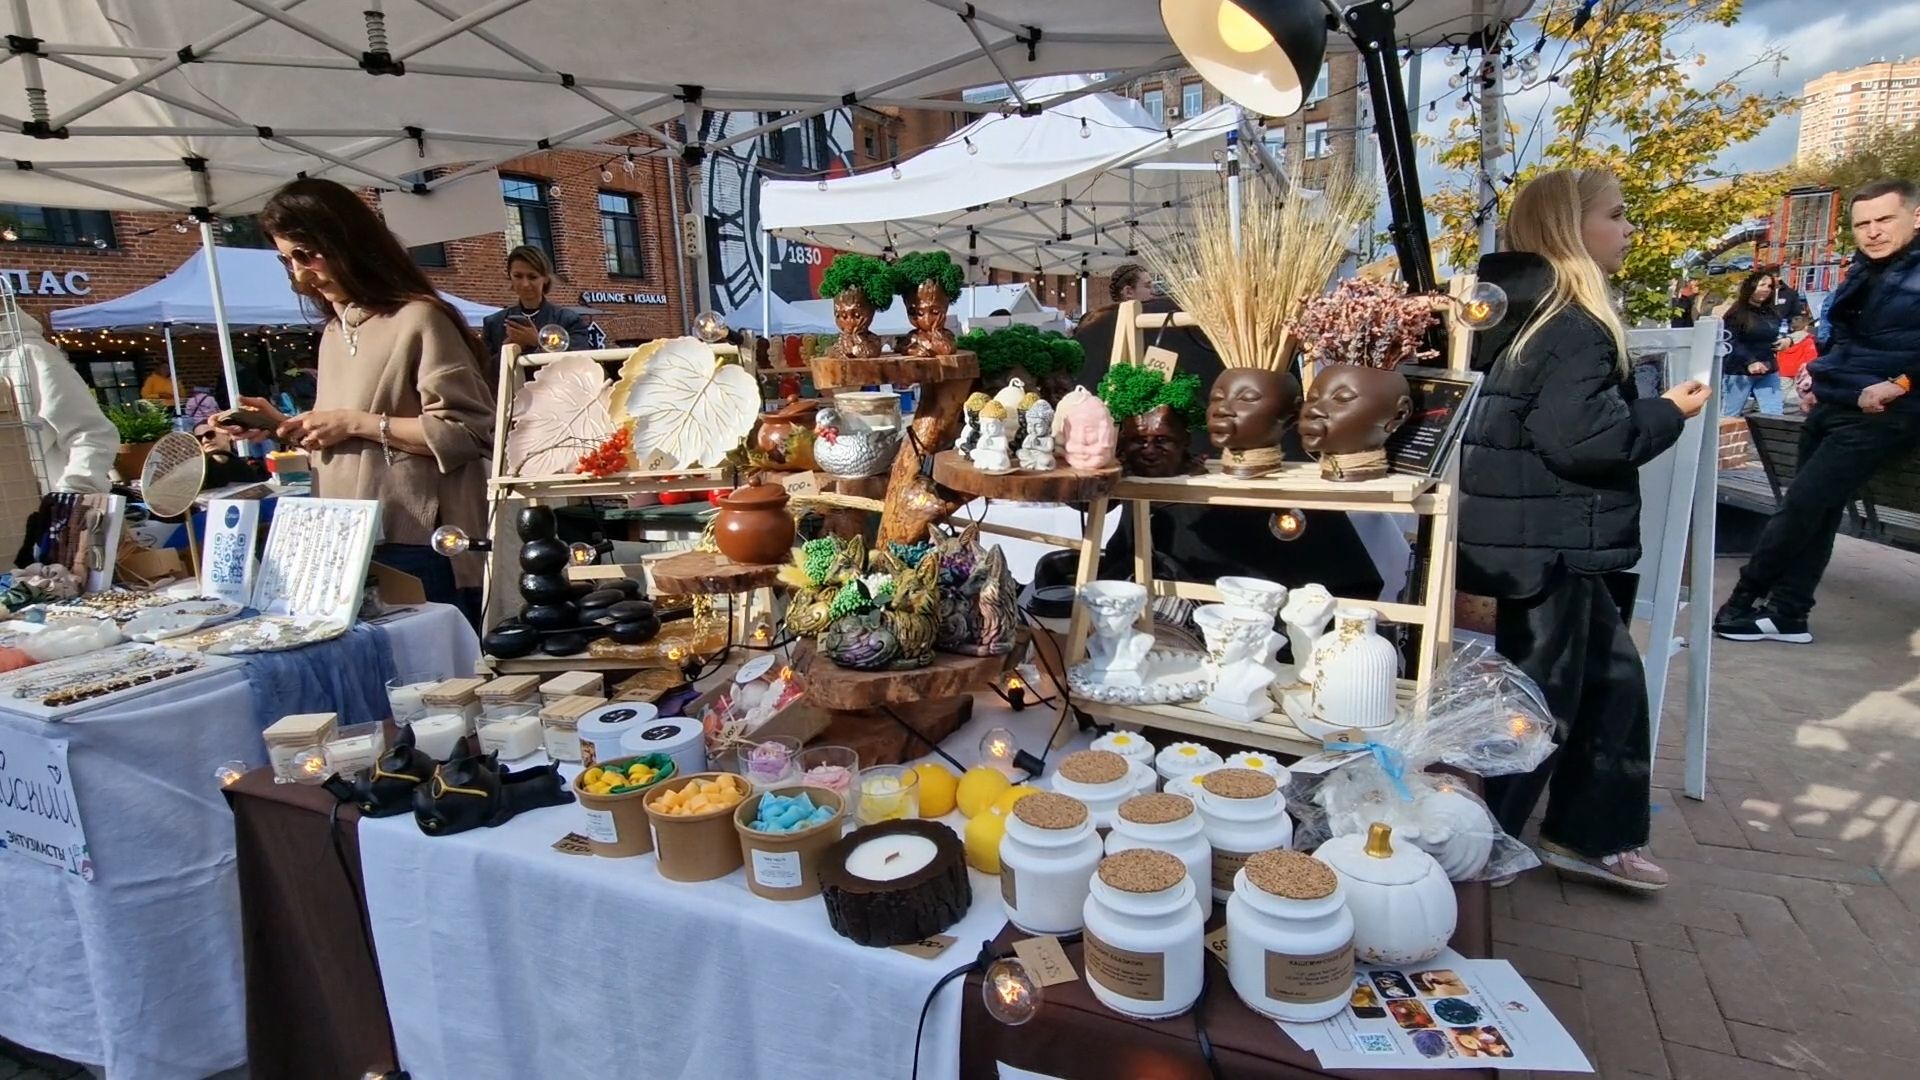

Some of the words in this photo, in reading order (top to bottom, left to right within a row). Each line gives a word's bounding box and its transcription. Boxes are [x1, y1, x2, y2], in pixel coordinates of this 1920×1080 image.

[788, 246, 822, 266] 1830
[591, 292, 627, 303] LOUNGE
[634, 293, 667, 304] ИЗАКАЯ
